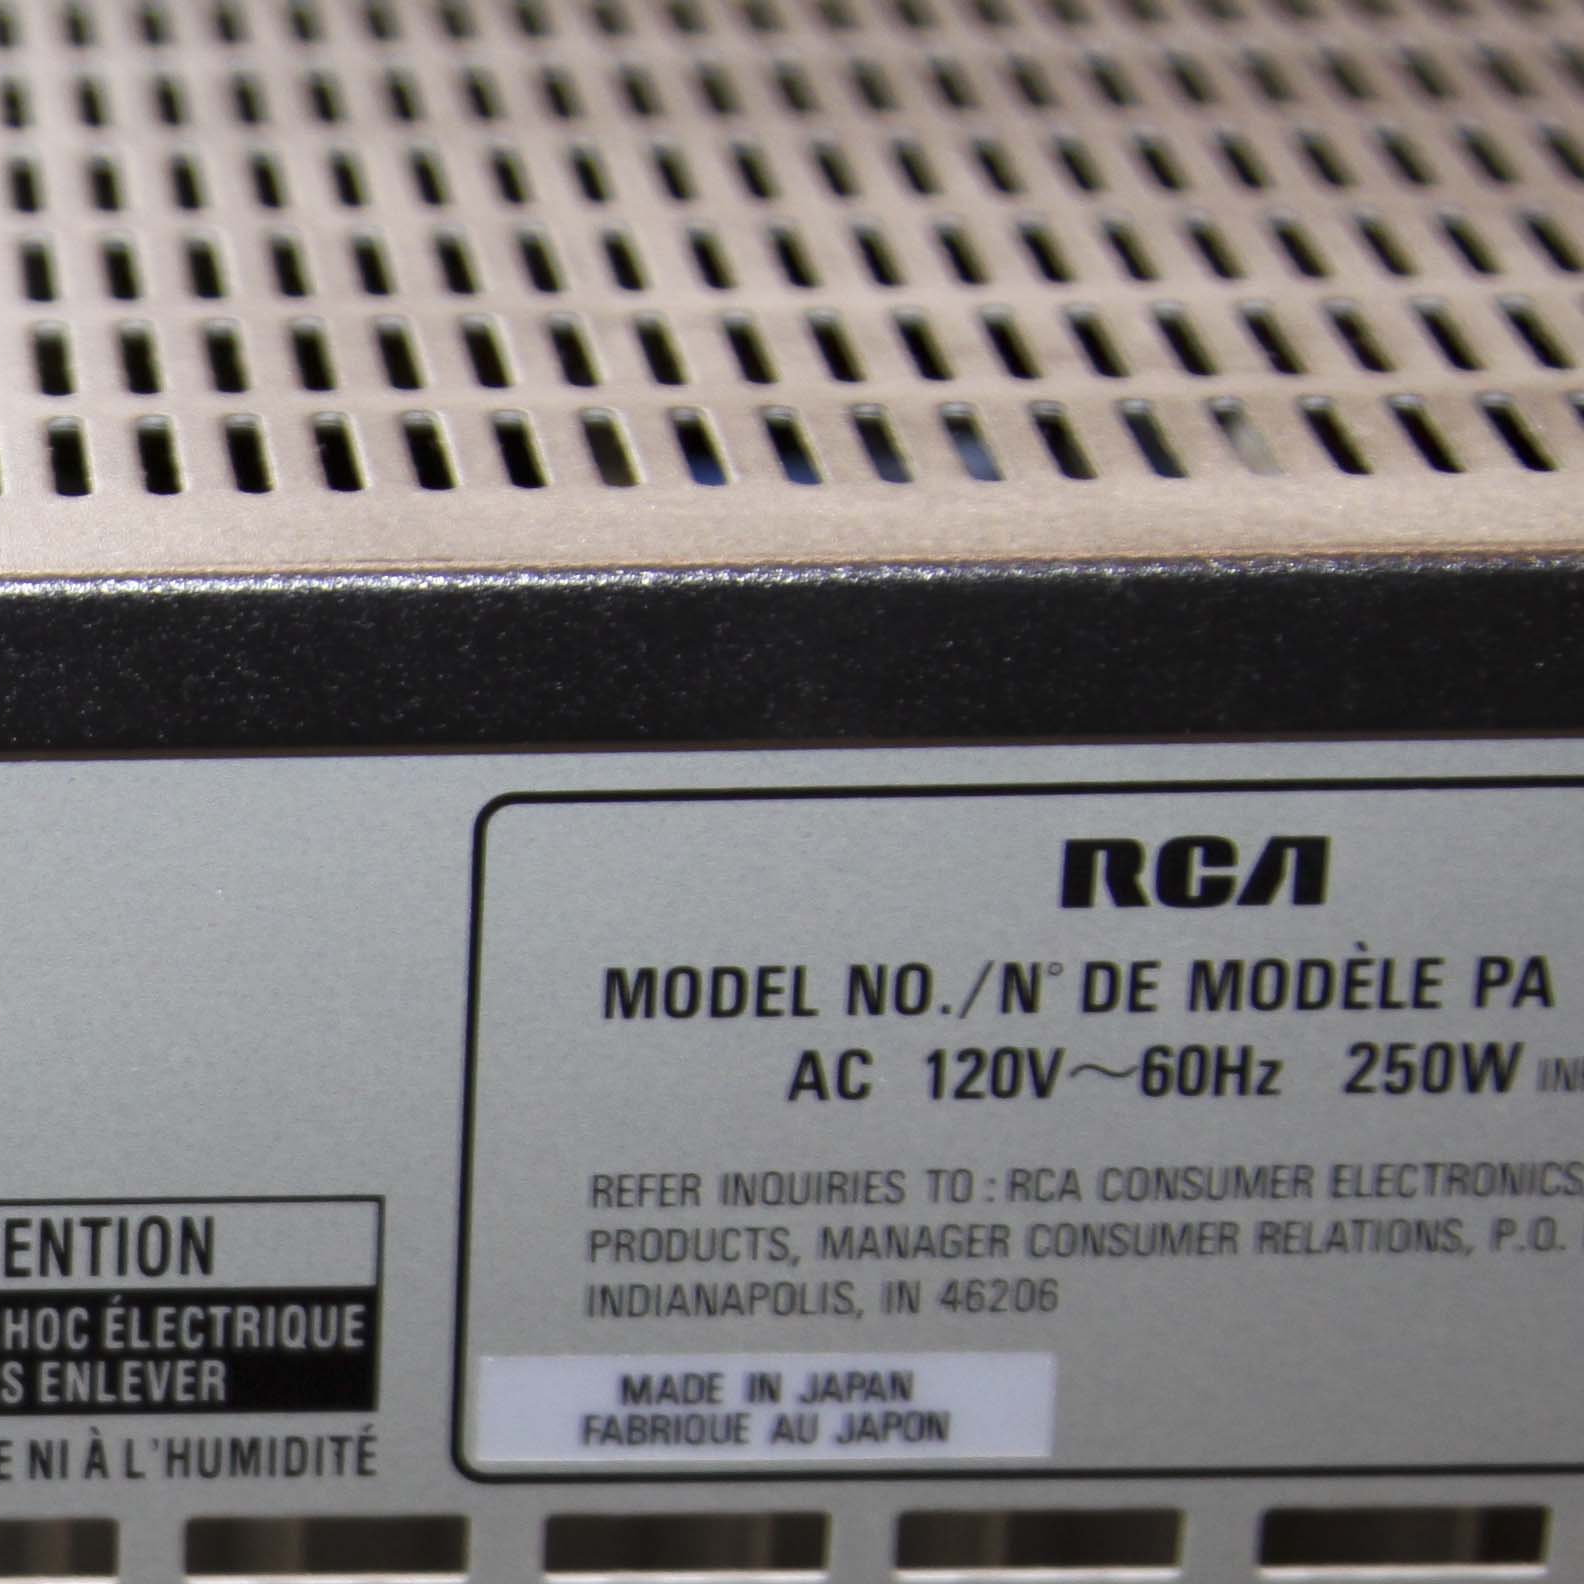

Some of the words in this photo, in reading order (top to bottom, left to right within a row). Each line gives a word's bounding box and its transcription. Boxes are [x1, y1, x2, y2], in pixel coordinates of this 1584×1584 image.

[1061, 836, 1329, 908] RCA
[604, 966, 817, 1019] MODEL
[1082, 961, 1159, 1013] DE
[1189, 942, 1443, 1012] MODÈLE
[1474, 956, 1553, 1008] PA
[788, 1049, 872, 1101] AC
[1344, 1042, 1522, 1095] 250W
[591, 1173, 701, 1208] REFER
[720, 1169, 905, 1207] INQUIRIES
[1006, 1168, 1081, 1203] RCA
[1099, 1164, 1314, 1202] CONSUMER
[588, 1226, 800, 1267] PRODUCTS,
[820, 1224, 1010, 1260] MANAGER
[1027, 1221, 1239, 1259] CONSUMER
[1255, 1217, 1473, 1256] RELATIONS,
[1490, 1216, 1566, 1252] P.O.
[104, 1295, 364, 1349] ÉLECTRIQUE
[587, 1281, 863, 1319] INDIANAPOLIS,
[884, 1280, 920, 1314] IN
[938, 1278, 1058, 1314] 46206
[40, 1360, 225, 1403] ENLEVER
[620, 1373, 721, 1406] MADE
[746, 1373, 780, 1403] IN
[799, 1371, 912, 1404] JAPAN
[29, 1440, 68, 1479] NI
[84, 1427, 108, 1479] À
[581, 1412, 749, 1446] FABRIQUE
[770, 1414, 818, 1444] AU
[836, 1410, 949, 1444] JAPON
